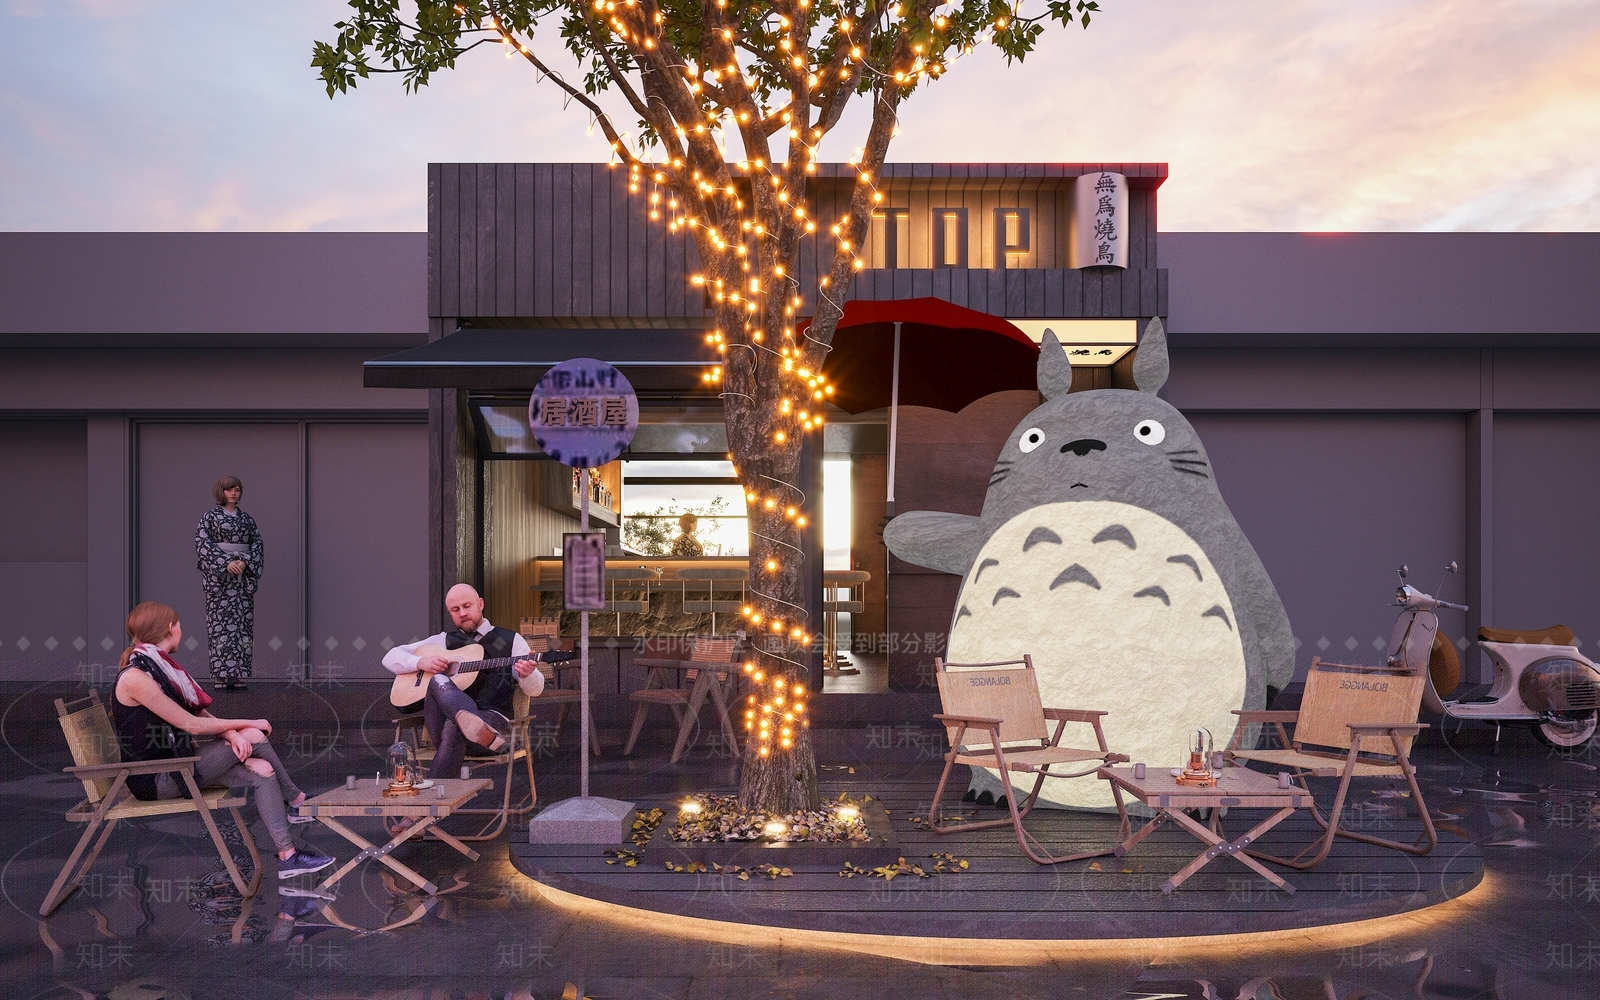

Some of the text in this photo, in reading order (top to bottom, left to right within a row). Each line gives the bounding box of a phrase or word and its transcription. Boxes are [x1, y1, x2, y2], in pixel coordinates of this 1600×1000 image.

[872, 208, 1029, 268] TOP
[541, 397, 628, 426] 居酒屋
